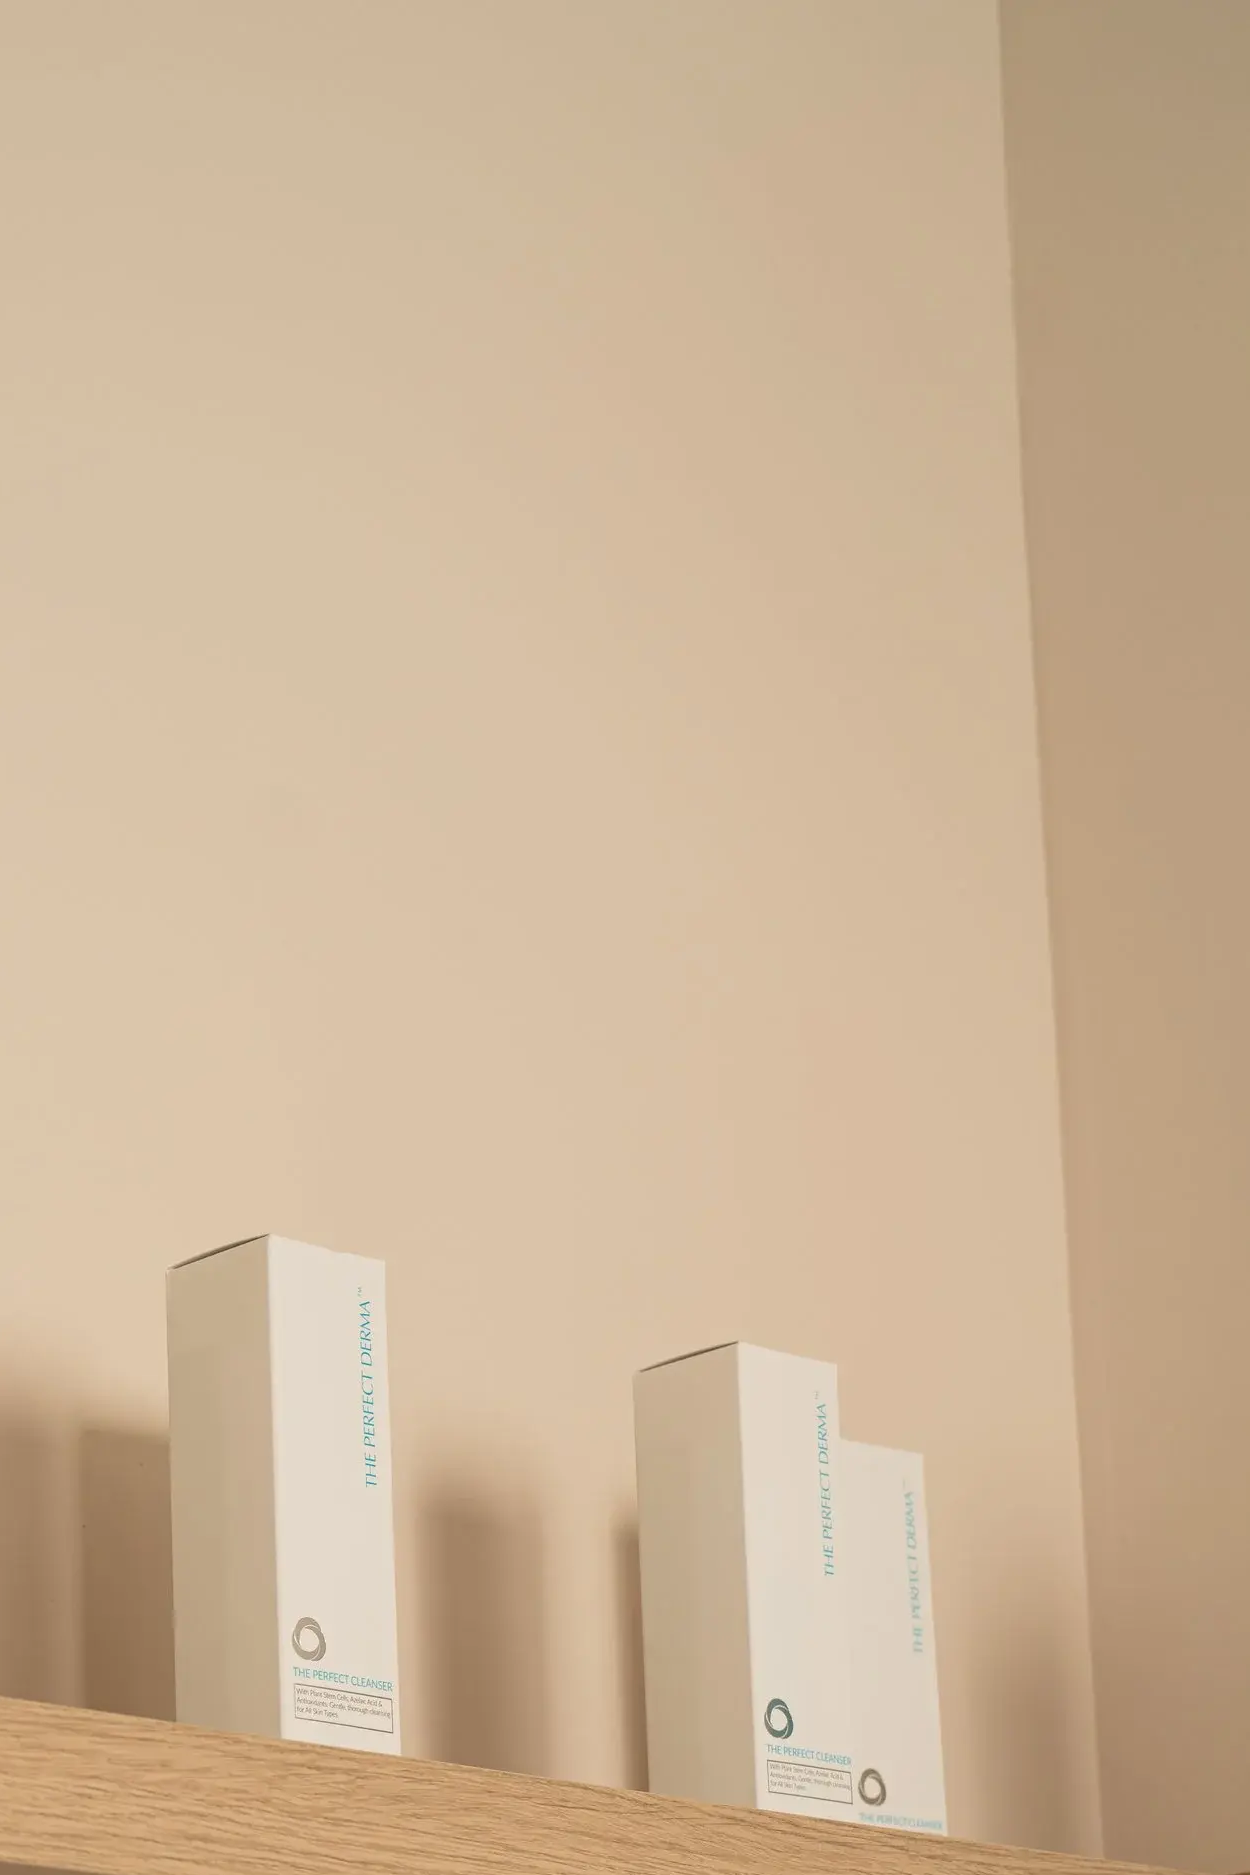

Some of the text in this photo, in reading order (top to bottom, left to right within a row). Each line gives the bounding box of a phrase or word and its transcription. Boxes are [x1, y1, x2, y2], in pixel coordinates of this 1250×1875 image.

[361, 1371, 375, 1448] PERFECT
[364, 1452, 378, 1488] THE
[819, 1470, 833, 1540] PERFECT
[823, 1545, 835, 1577] THE
[293, 1666, 393, 1691] THE PERFECT CLEANSER
[767, 1744, 851, 1765] THE PERFECT CLEANSER
